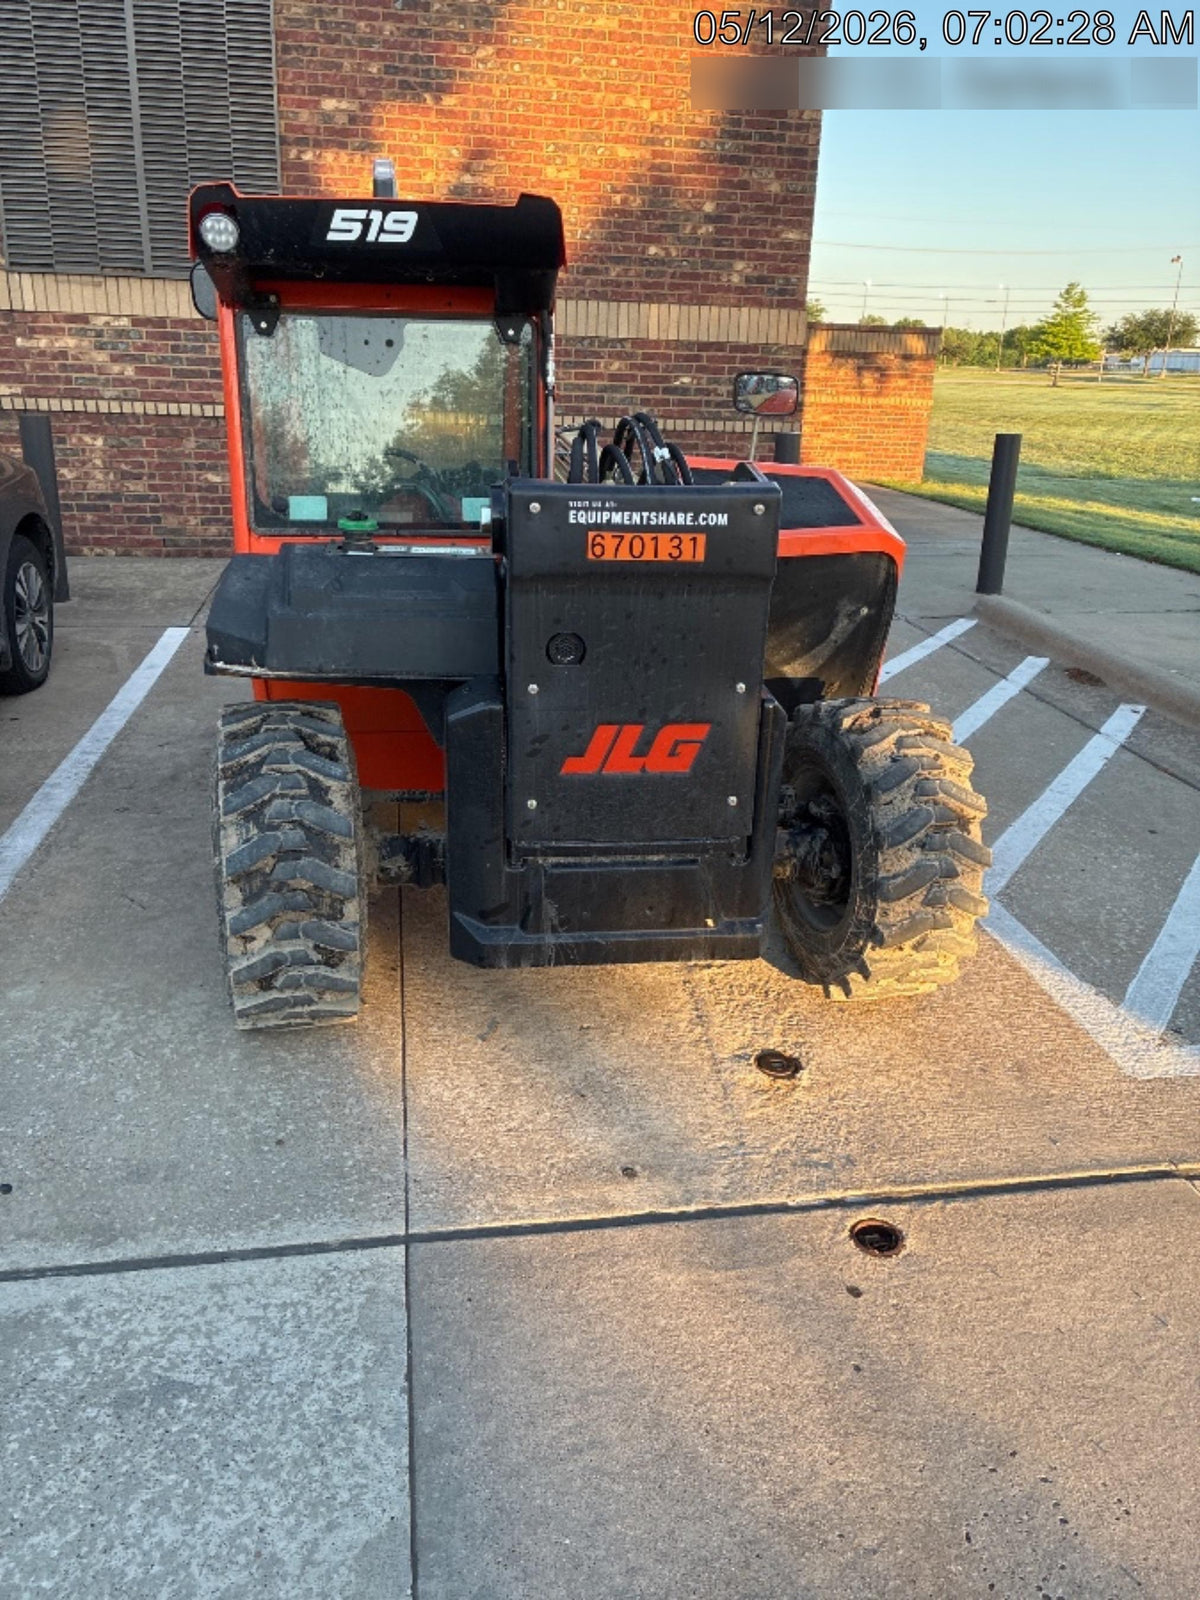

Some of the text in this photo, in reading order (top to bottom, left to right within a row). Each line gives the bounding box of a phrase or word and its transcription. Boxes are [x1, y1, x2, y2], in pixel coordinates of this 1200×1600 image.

[326, 209, 418, 243] 519
[568, 510, 729, 527] EQUIPMENTSHARE.COM
[590, 533, 698, 560] 670131
[559, 722, 712, 776] JLG
